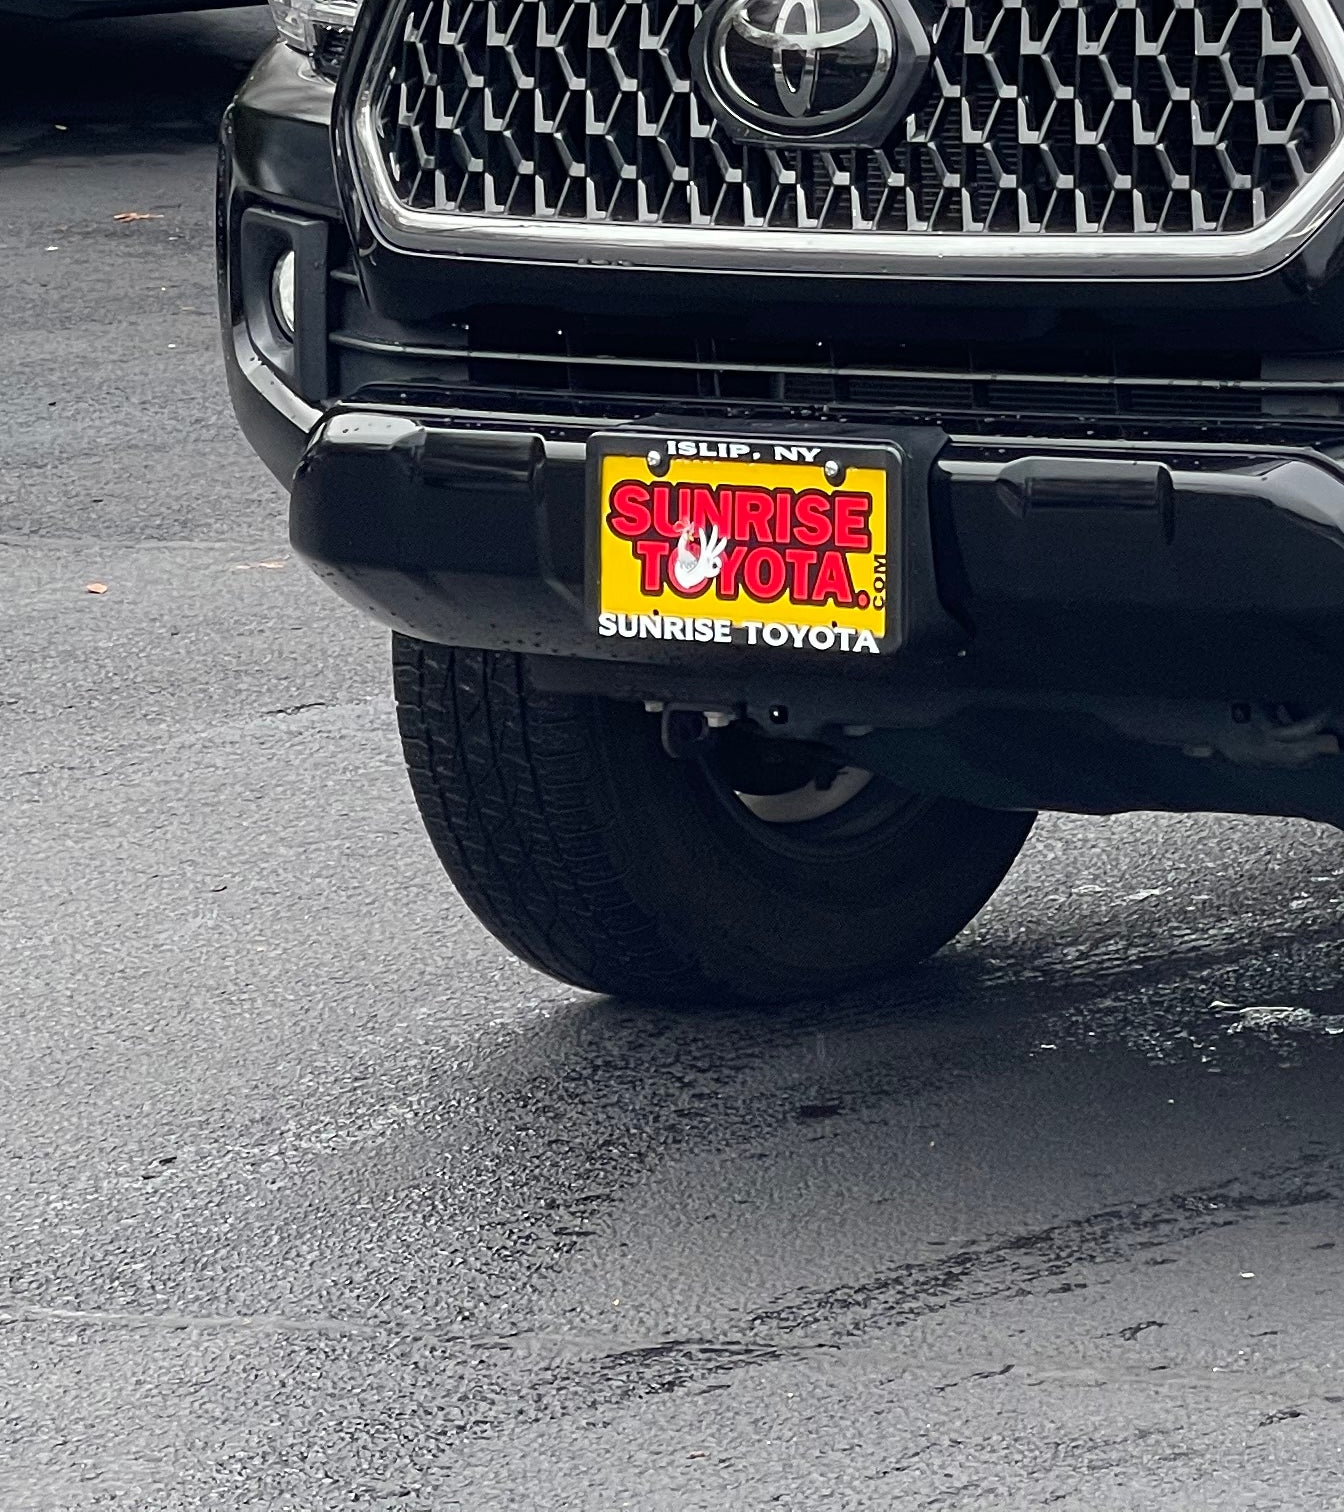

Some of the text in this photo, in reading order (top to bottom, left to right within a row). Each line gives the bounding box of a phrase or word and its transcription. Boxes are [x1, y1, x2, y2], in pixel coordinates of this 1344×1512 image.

[667, 440, 822, 463] ISLIP, NY
[607, 482, 873, 551] SUNRISE
[598, 612, 880, 654] SUNRISE TOYOTA
